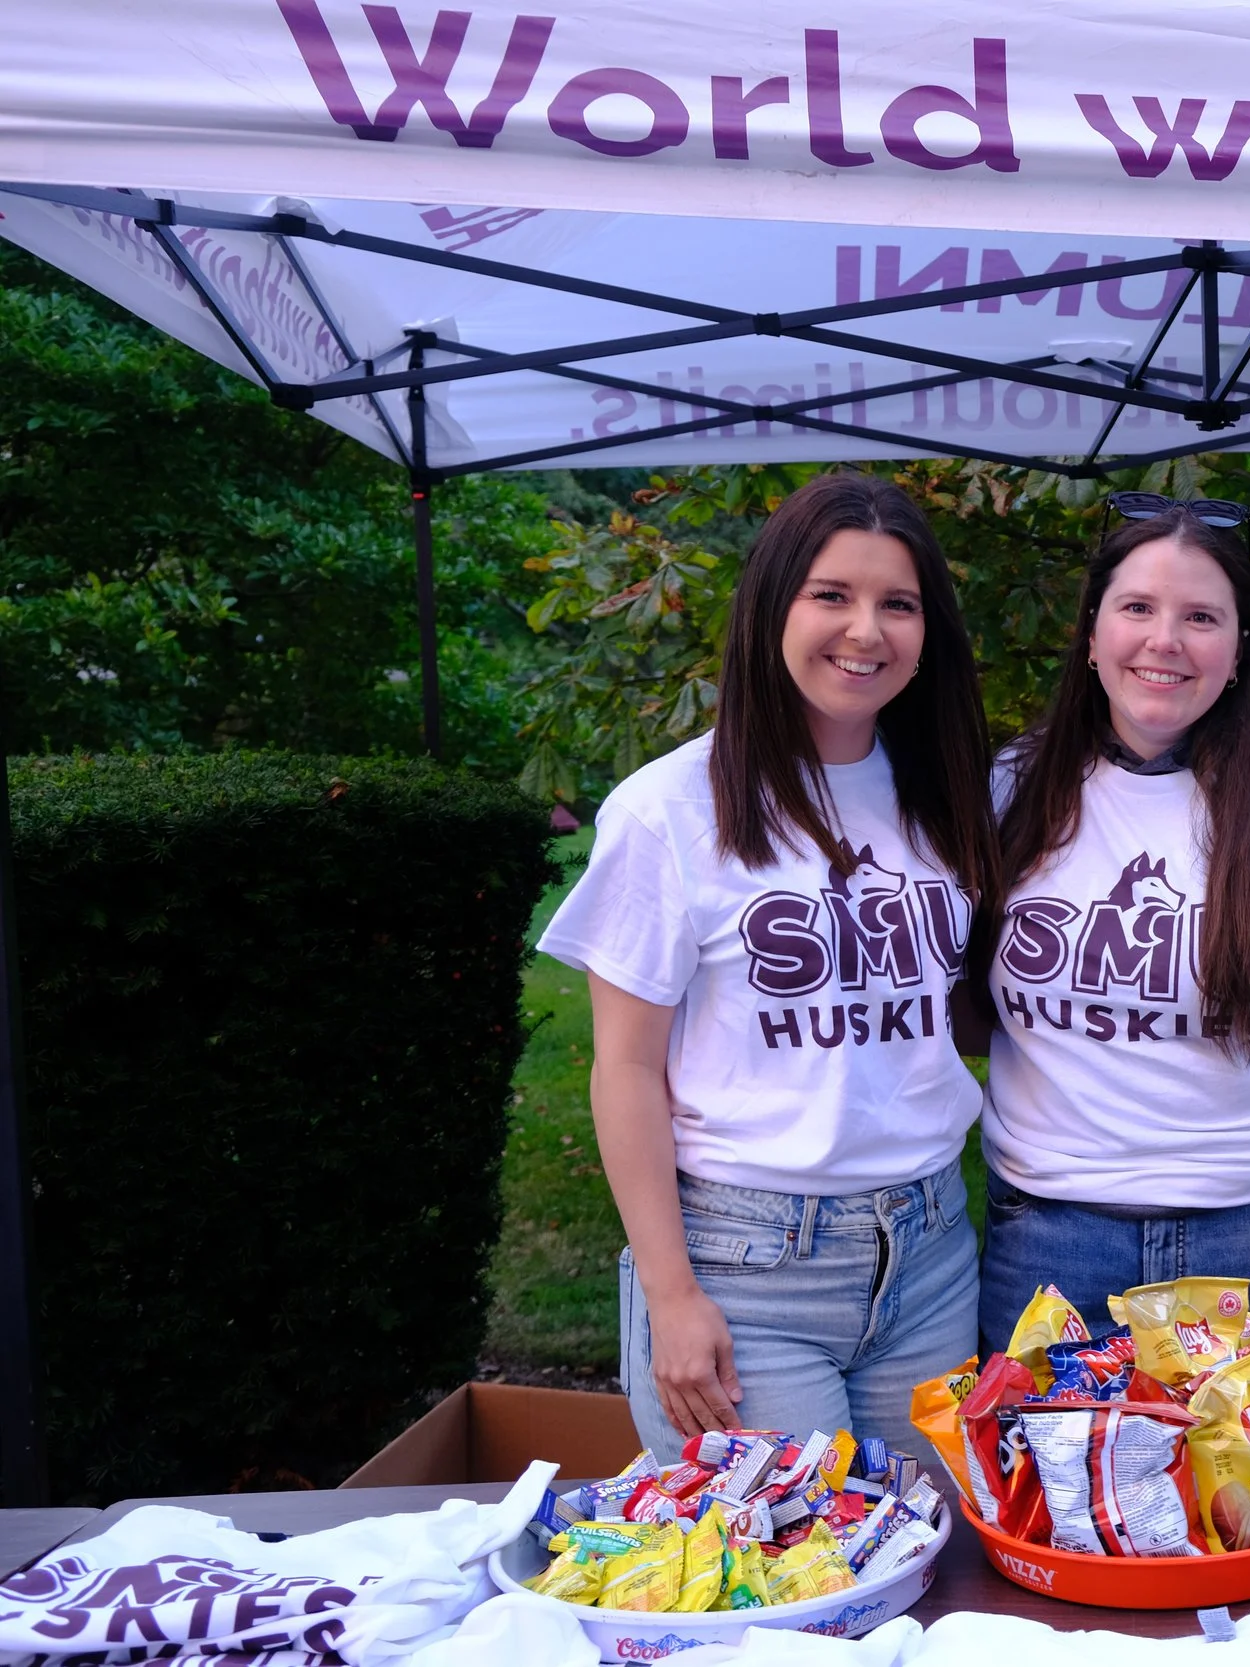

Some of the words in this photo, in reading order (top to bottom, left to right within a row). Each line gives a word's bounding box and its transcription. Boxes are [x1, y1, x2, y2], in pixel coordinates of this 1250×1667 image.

[275, 0, 1022, 173] World
[738, 880, 979, 998] SMU
[758, 995, 951, 1049] HUSKI
[1175, 1320, 1212, 1355] Lay's
[996, 1548, 1057, 1586] VIZZY
[845, 1601, 889, 1632] LIGHT
[616, 1637, 671, 1661] Coors
